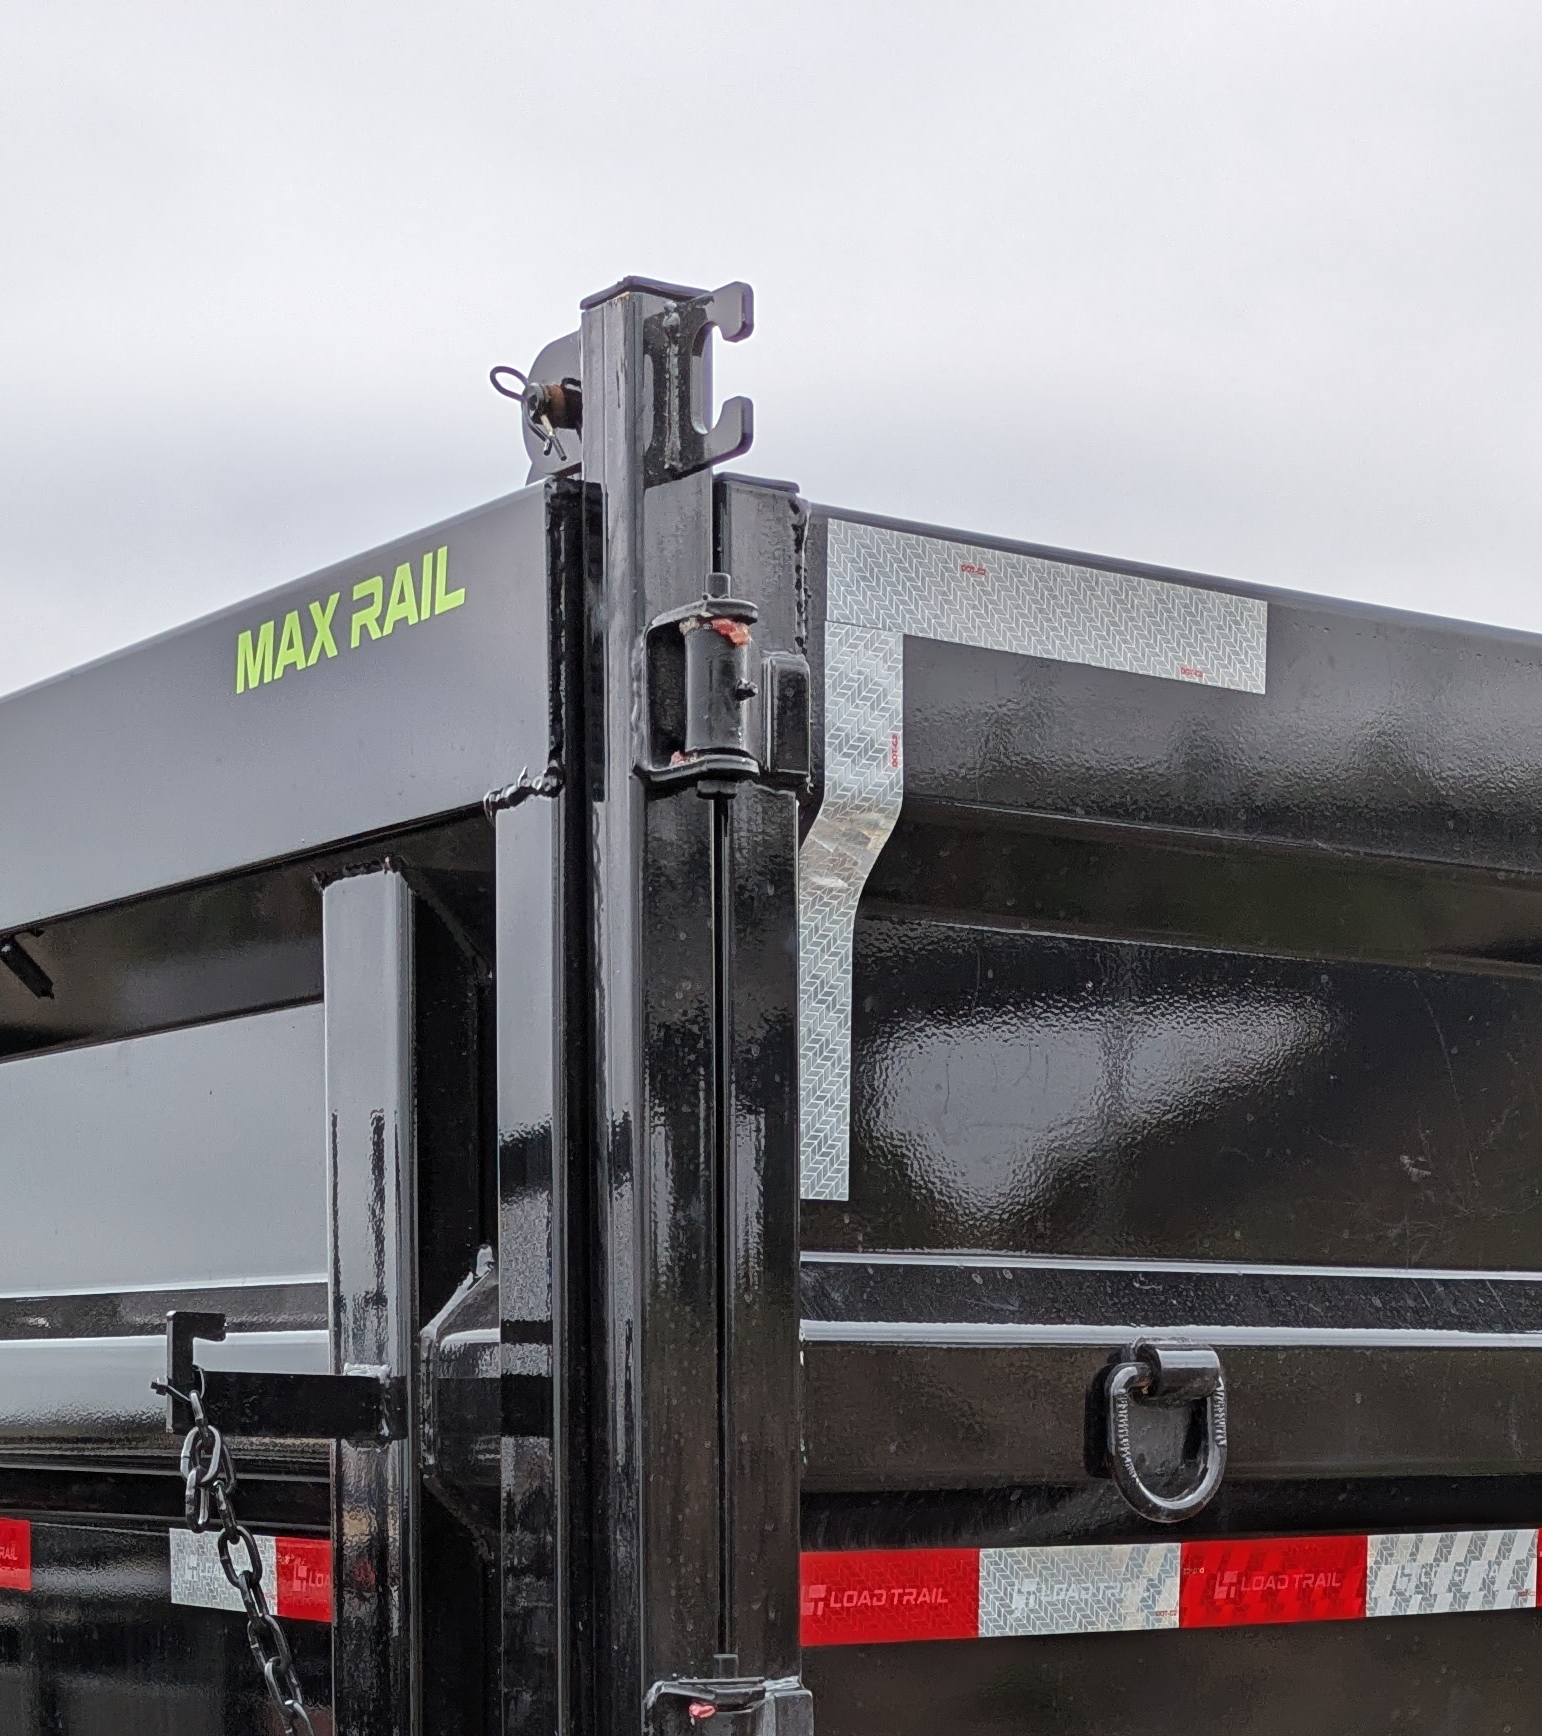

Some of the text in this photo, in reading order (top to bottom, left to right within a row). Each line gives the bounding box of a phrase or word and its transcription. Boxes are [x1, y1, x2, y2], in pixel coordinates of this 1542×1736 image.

[236, 545, 466, 694] MAX RAIL
[308, 1570, 331, 1588] LOA
[1240, 1571, 1343, 1592] LOAD TRAIL
[829, 1587, 950, 1608] LOAD TRAIL
